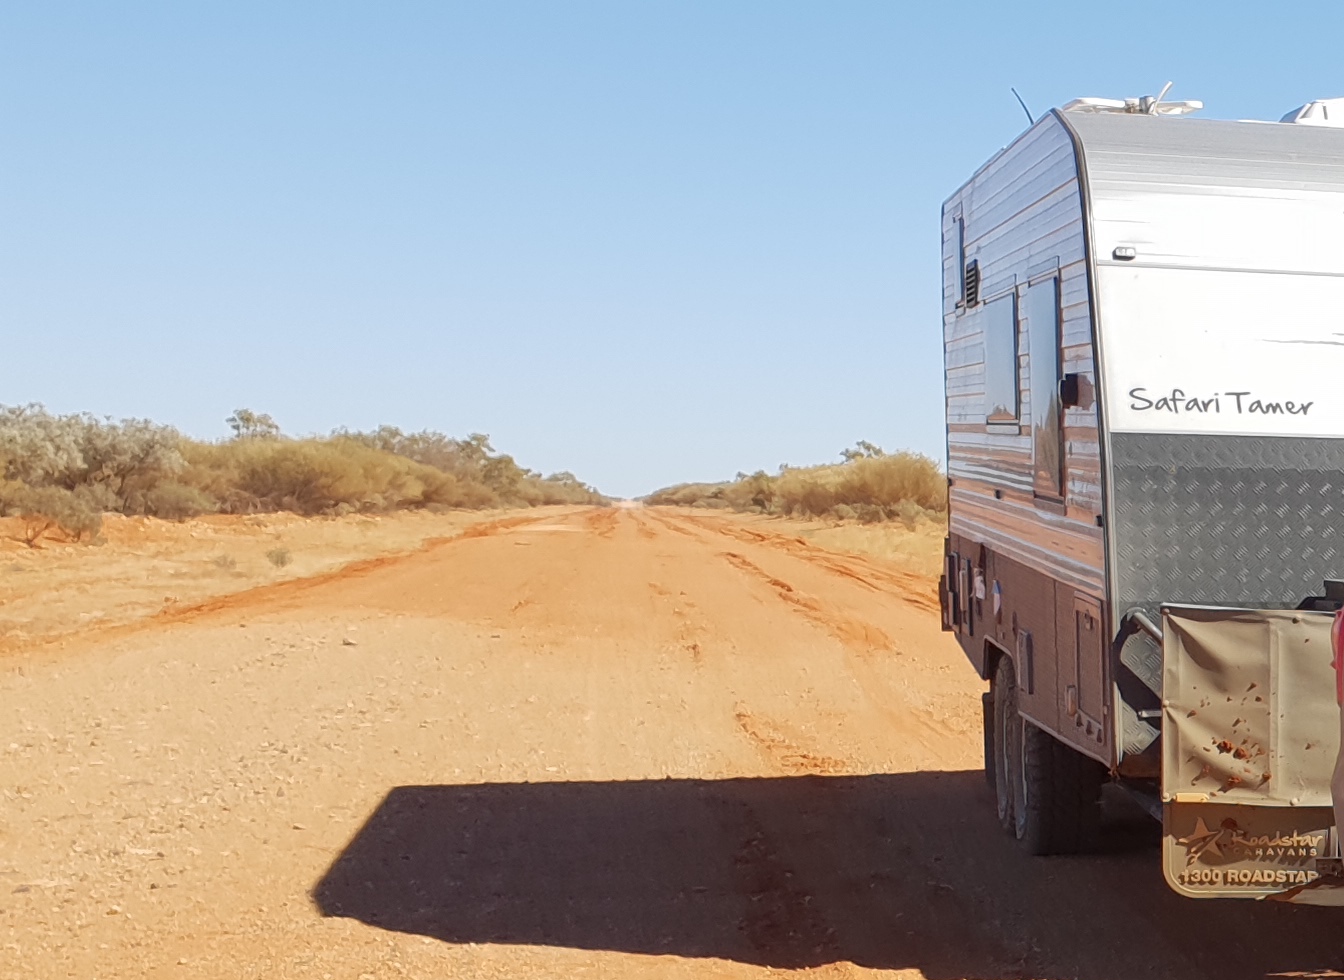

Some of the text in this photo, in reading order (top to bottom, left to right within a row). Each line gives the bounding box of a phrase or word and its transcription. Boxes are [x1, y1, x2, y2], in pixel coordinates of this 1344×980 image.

[1129, 387, 1314, 416] Safari Tamer
[1231, 829, 1323, 848] Roadstar
[1183, 869, 1222, 883] 1300
